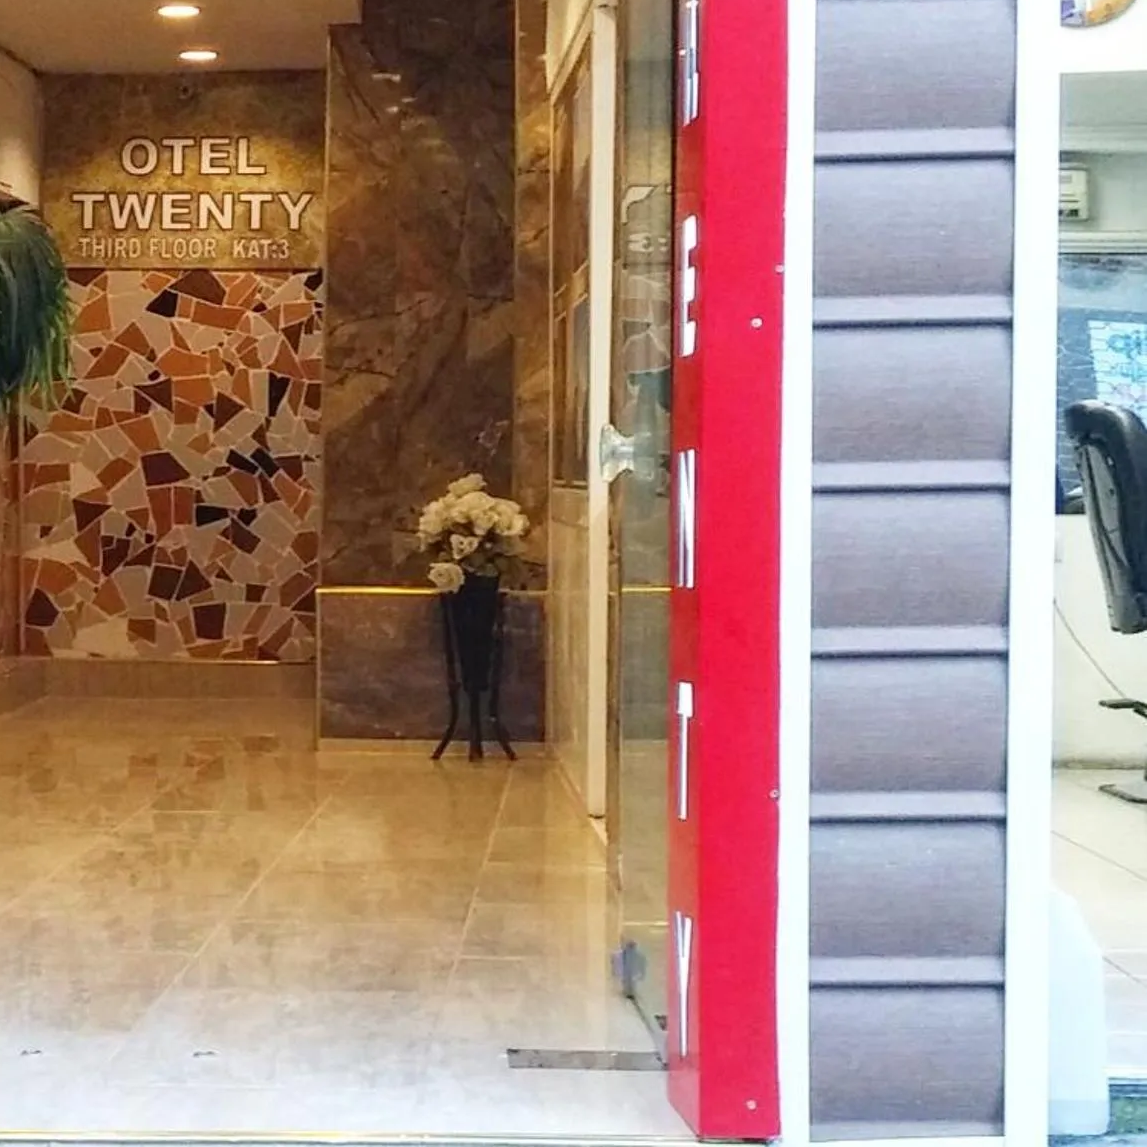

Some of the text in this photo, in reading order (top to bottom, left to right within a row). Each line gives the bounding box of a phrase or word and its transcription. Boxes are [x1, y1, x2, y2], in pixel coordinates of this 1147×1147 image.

[120, 136, 266, 175] OTEL
[71, 192, 313, 231] TWENTY
[78, 237, 290, 260] THIRD FLOOR KAT:3
